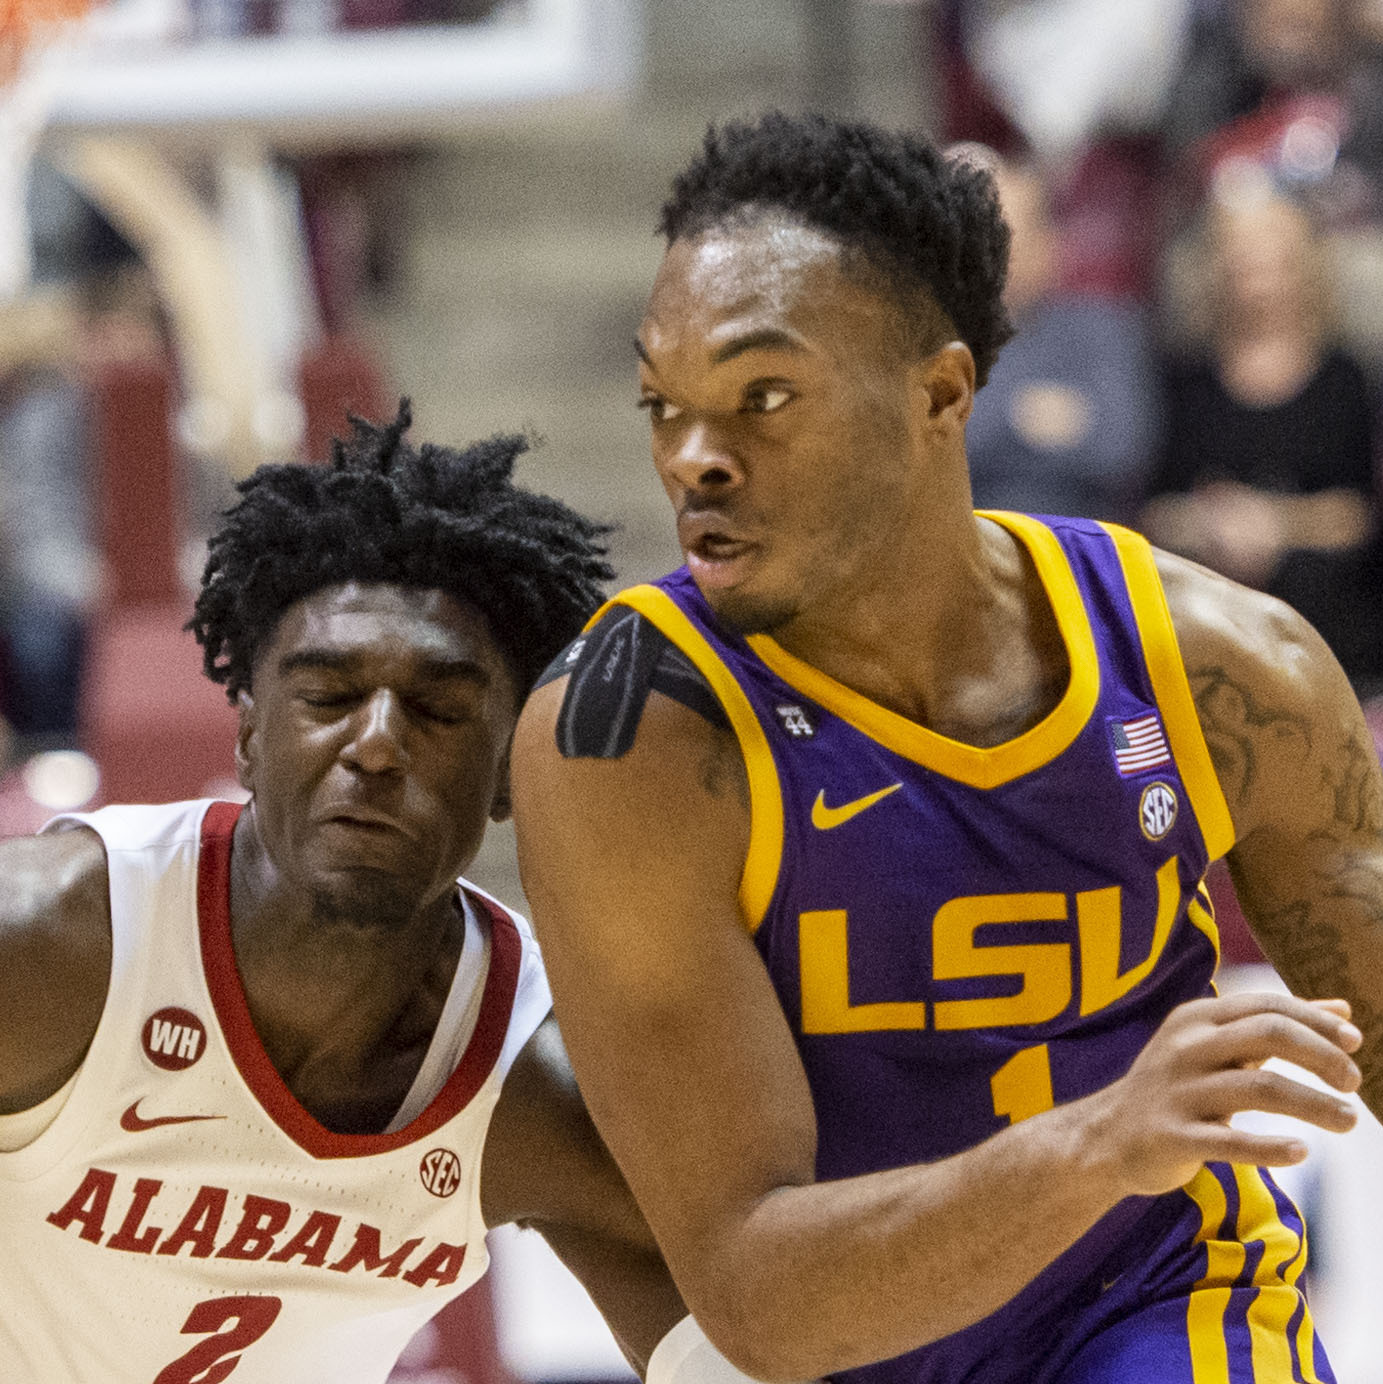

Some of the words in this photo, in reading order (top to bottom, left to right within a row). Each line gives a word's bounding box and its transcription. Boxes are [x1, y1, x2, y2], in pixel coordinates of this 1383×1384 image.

[1142, 786, 1176, 836] SEC
[798, 854, 1182, 1035] LSU
[149, 1018, 200, 1060] WH
[420, 1149, 460, 1197] SEC
[45, 1166, 468, 1288] ALABAMA
